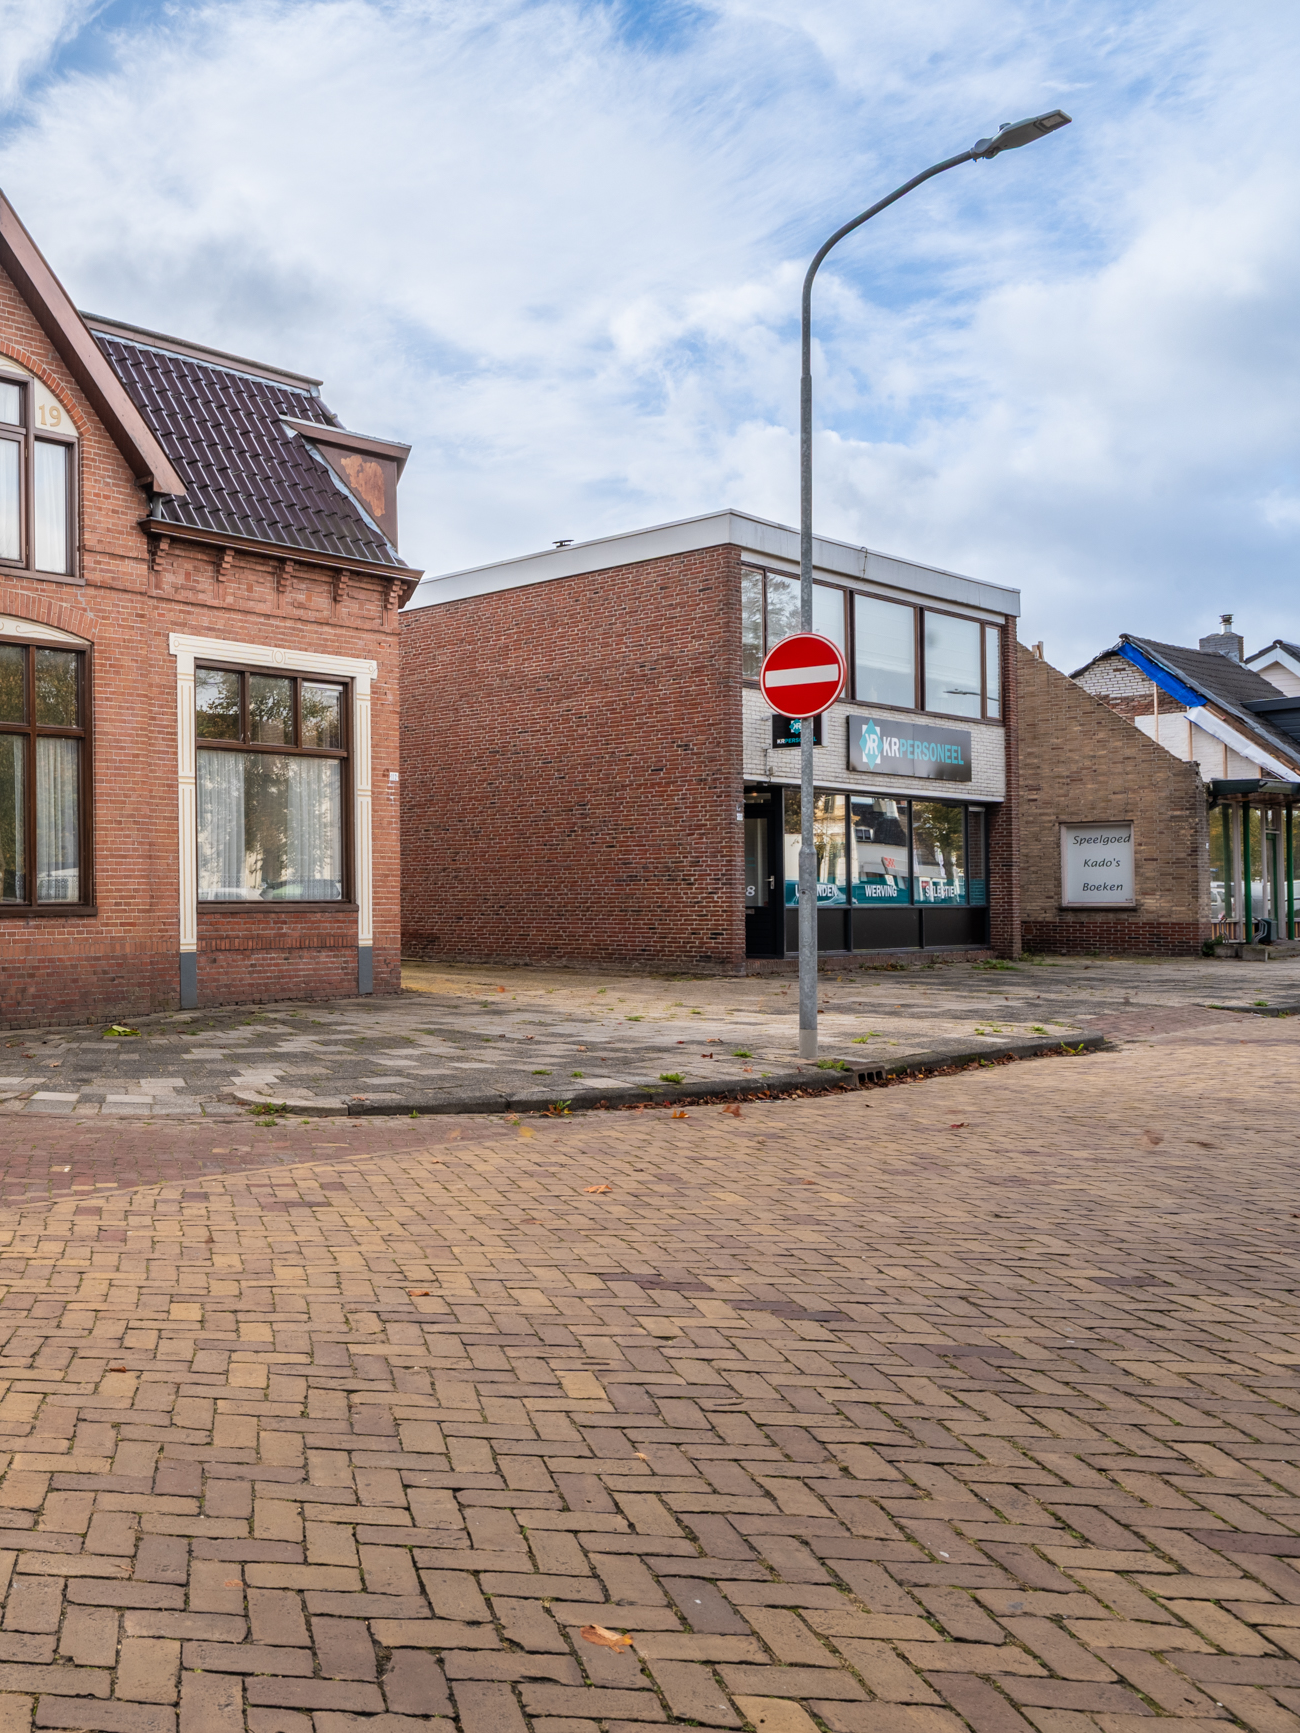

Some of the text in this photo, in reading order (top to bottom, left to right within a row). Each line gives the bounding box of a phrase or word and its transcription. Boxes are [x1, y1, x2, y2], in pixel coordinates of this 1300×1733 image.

[38, 403, 62, 427] 19
[776, 736, 817, 745] KRPERSL
[1072, 833, 1131, 846] Speelgoed
[1083, 857, 1121, 868] Kado's
[795, 884, 838, 897] UNDEN
[864, 885, 898, 897] WERVING
[1082, 882, 1123, 892] Boeken
